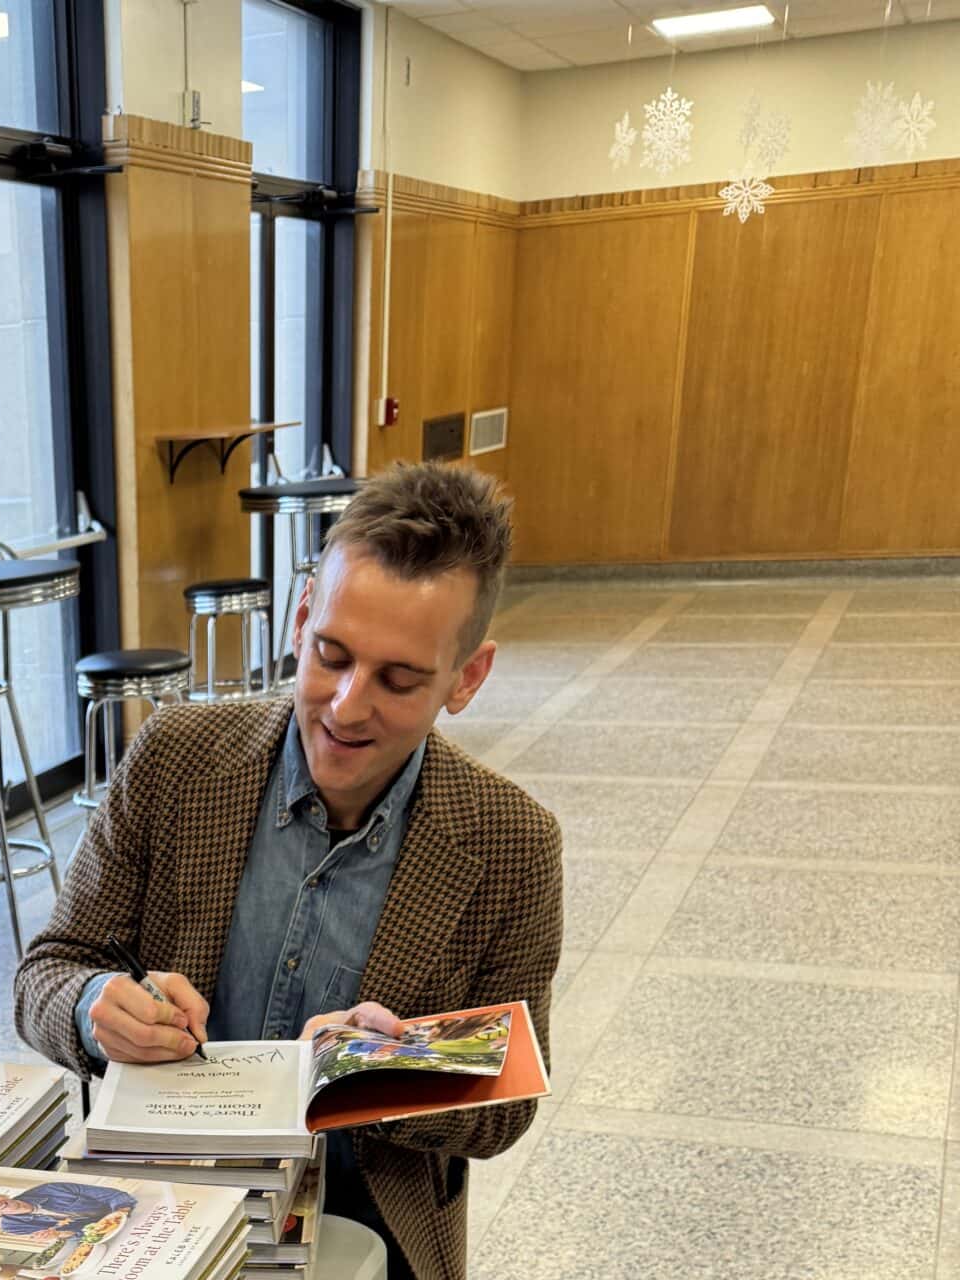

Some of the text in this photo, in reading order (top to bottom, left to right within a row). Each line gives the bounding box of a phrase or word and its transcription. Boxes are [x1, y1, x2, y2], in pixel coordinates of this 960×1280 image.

[165, 1199, 197, 1225] Table
[96, 1205, 168, 1276] There's Always
[151, 1224, 176, 1244] the
[144, 1246, 162, 1256] at
